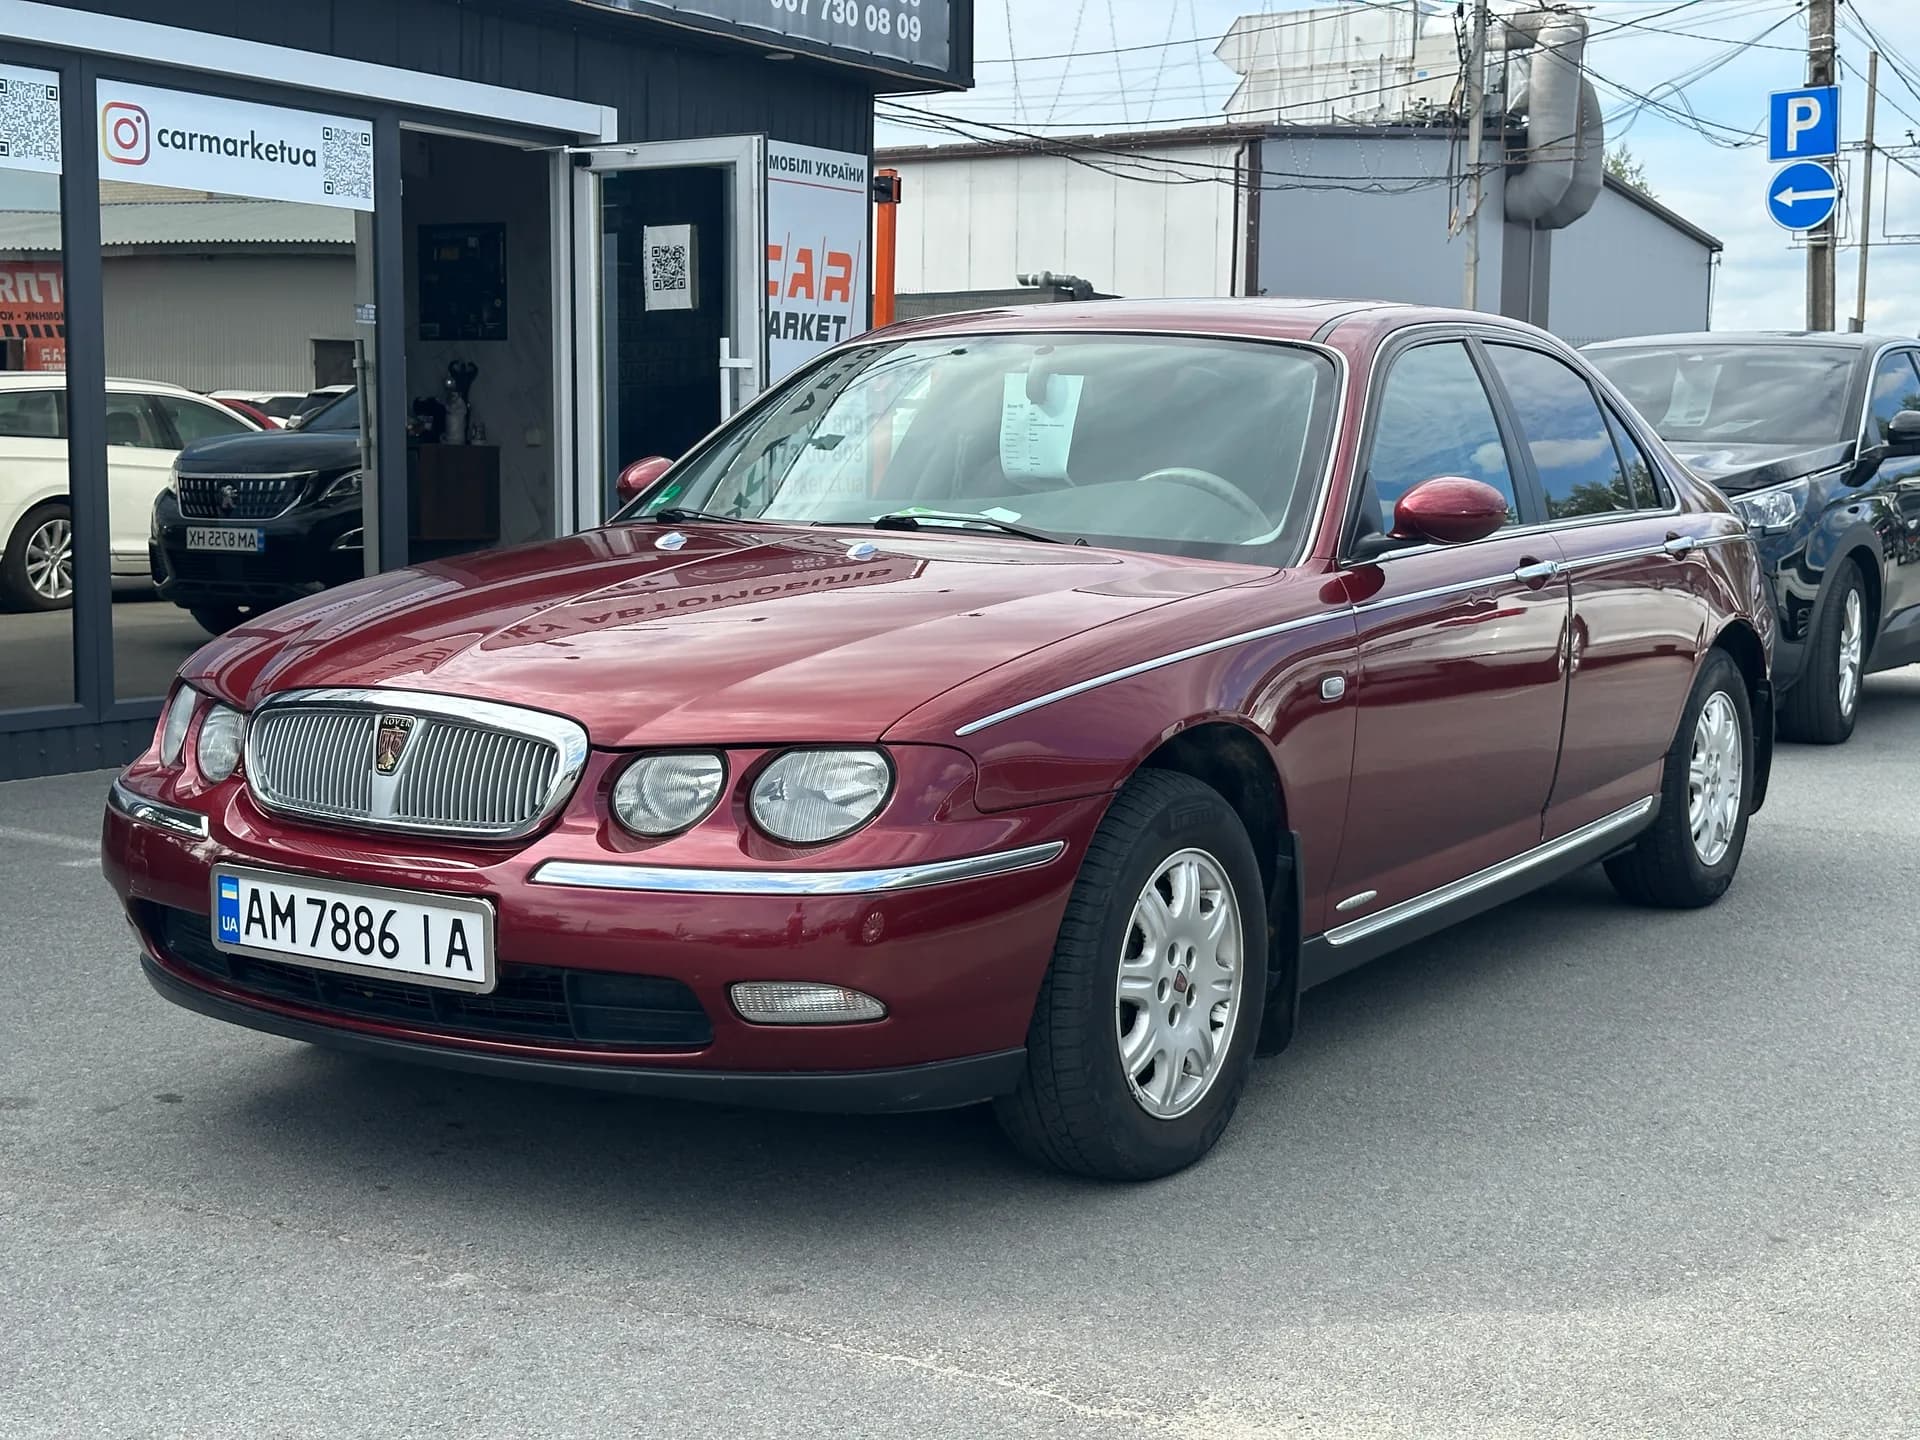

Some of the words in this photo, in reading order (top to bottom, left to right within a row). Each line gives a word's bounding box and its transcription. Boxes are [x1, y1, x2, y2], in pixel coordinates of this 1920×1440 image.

[821, 0, 859, 27] 730
[865, 4, 891, 35] 08
[896, 12, 922, 42] 09
[1786, 96, 1822, 152] P
[157, 128, 317, 168] carmarketua
[768, 154, 813, 175] МОБІЛІ
[815, 162, 864, 183] УКРАЇНИ
[222, 916, 238, 933] UA
[245, 888, 297, 944] AM
[306, 897, 400, 960] 7886
